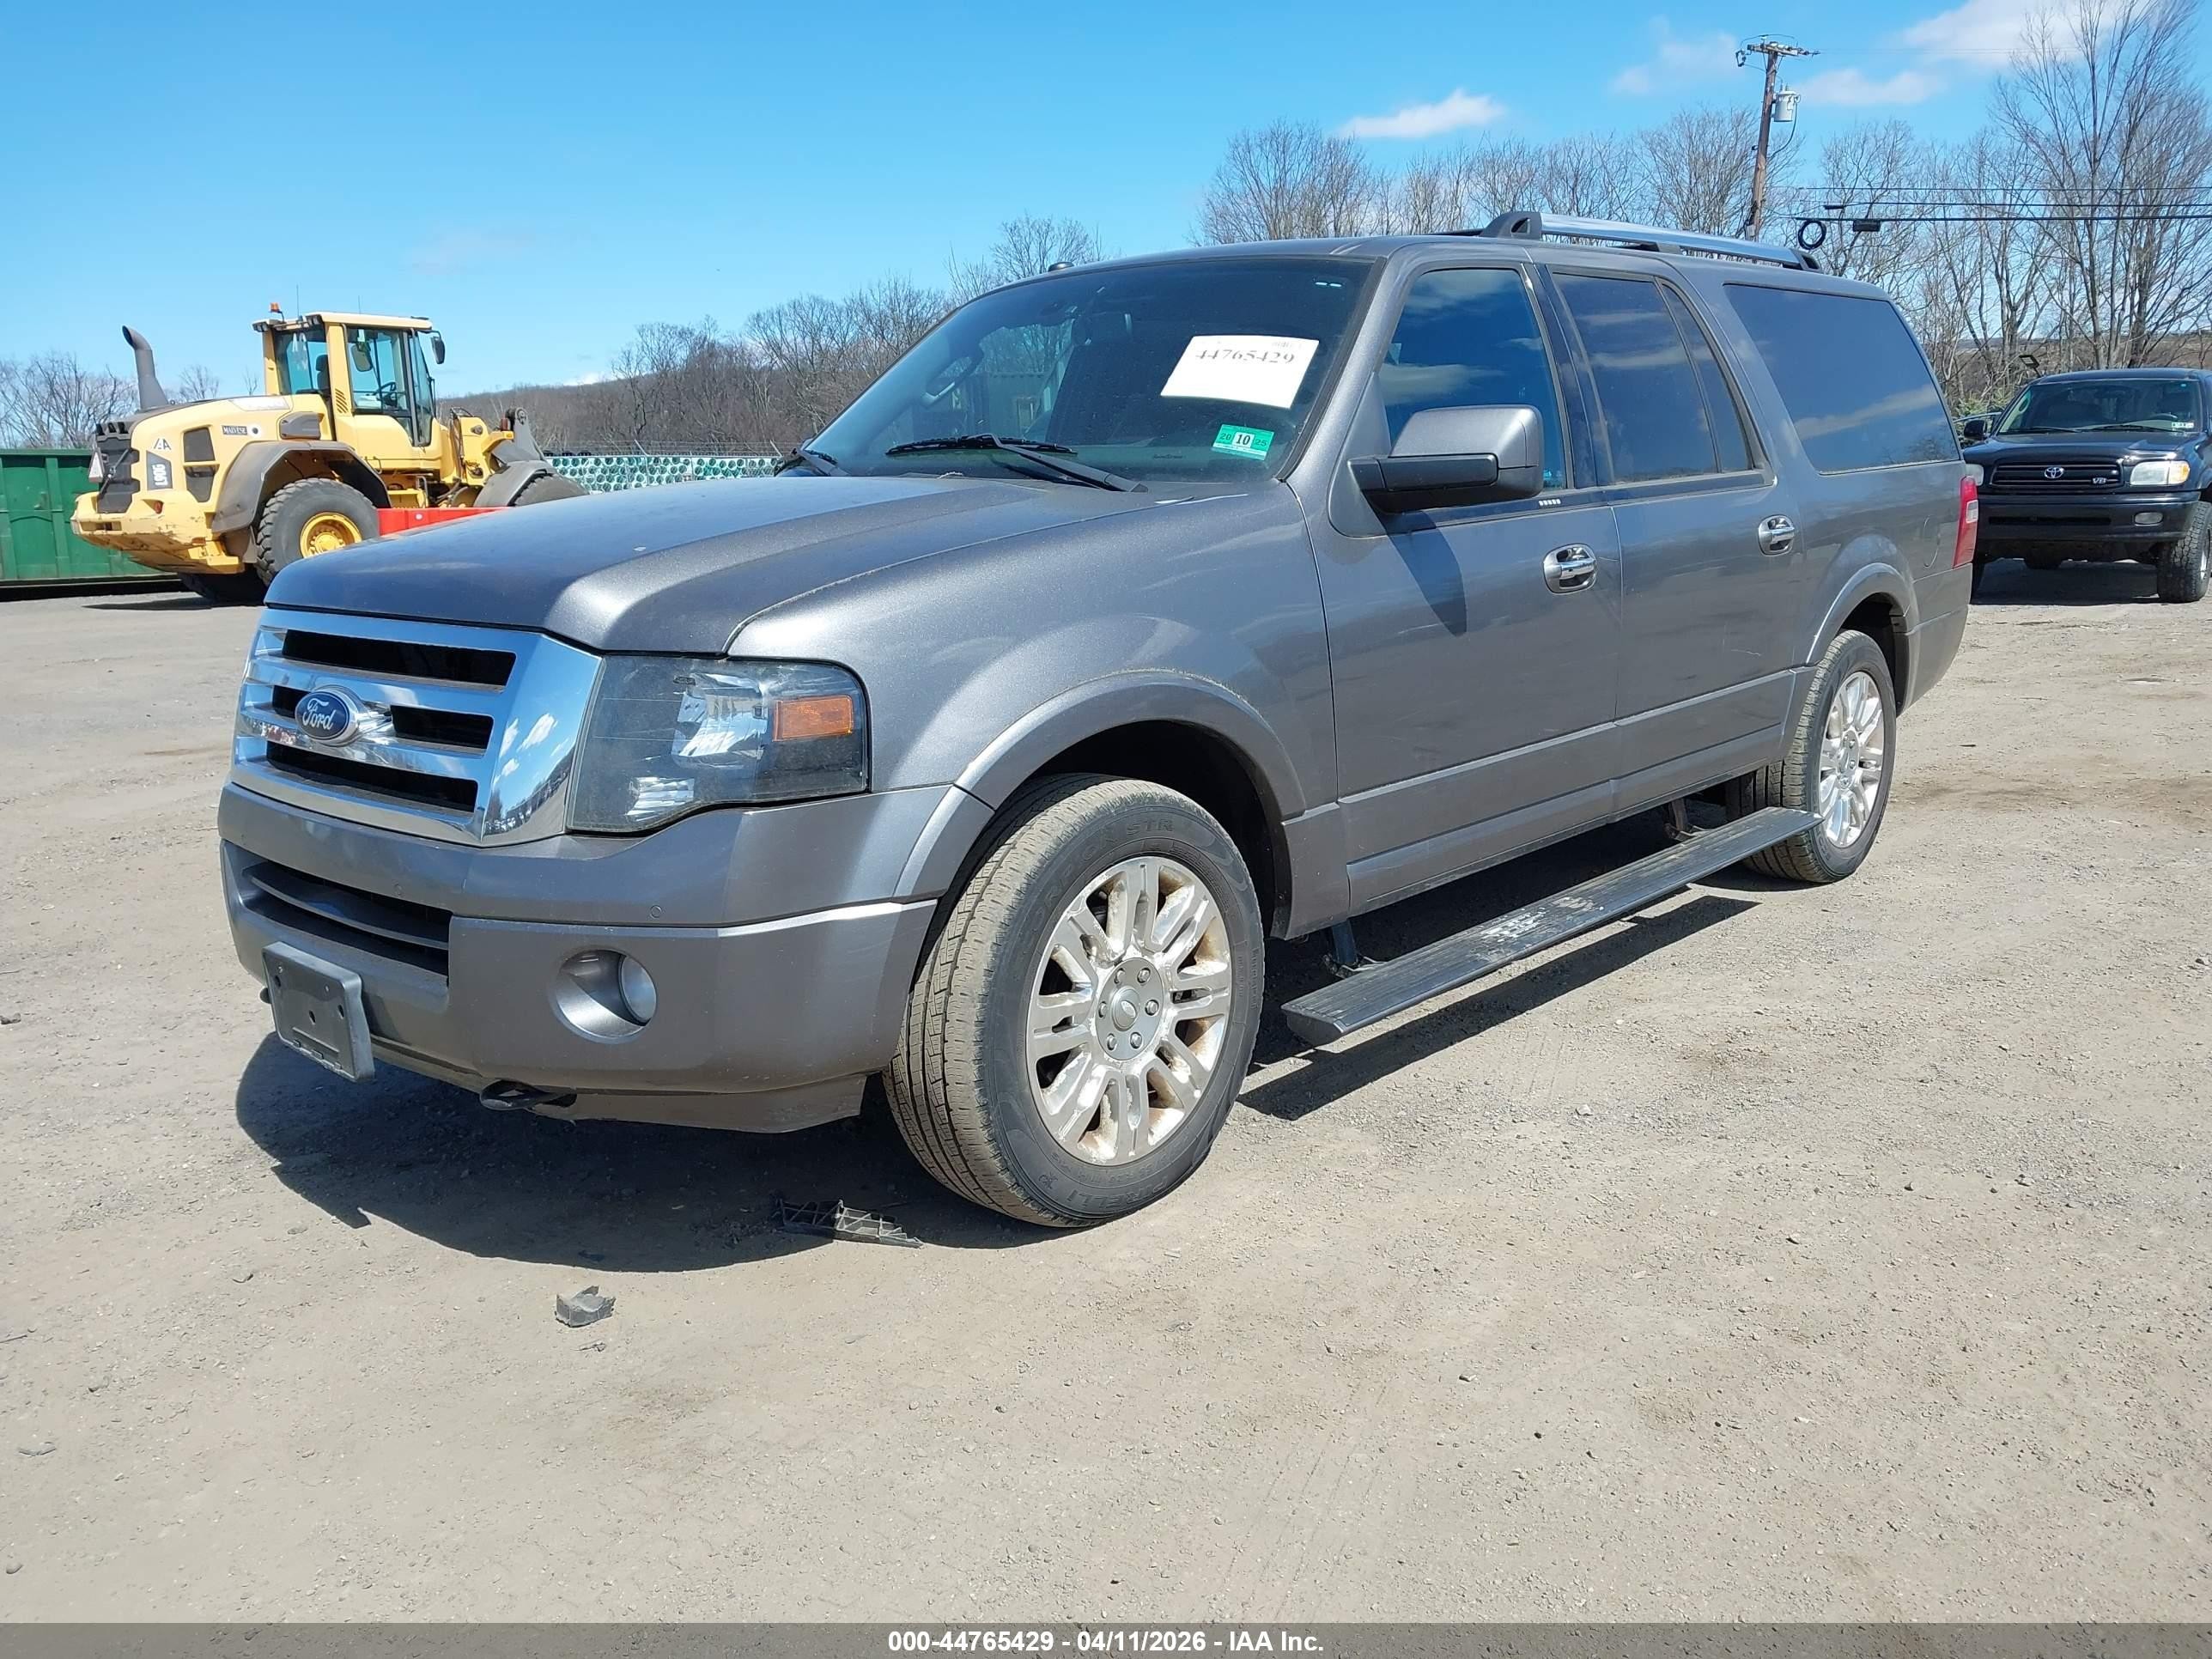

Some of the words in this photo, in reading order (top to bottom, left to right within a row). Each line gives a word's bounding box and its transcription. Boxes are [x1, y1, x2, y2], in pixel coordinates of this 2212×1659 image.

[1196, 349, 1295, 363] 44765429
[1236, 434, 1251, 446] 10
[152, 463, 168, 486] L90G
[302, 697, 337, 731] Ford
[1066, 1176, 1170, 1210] PIRELLI
